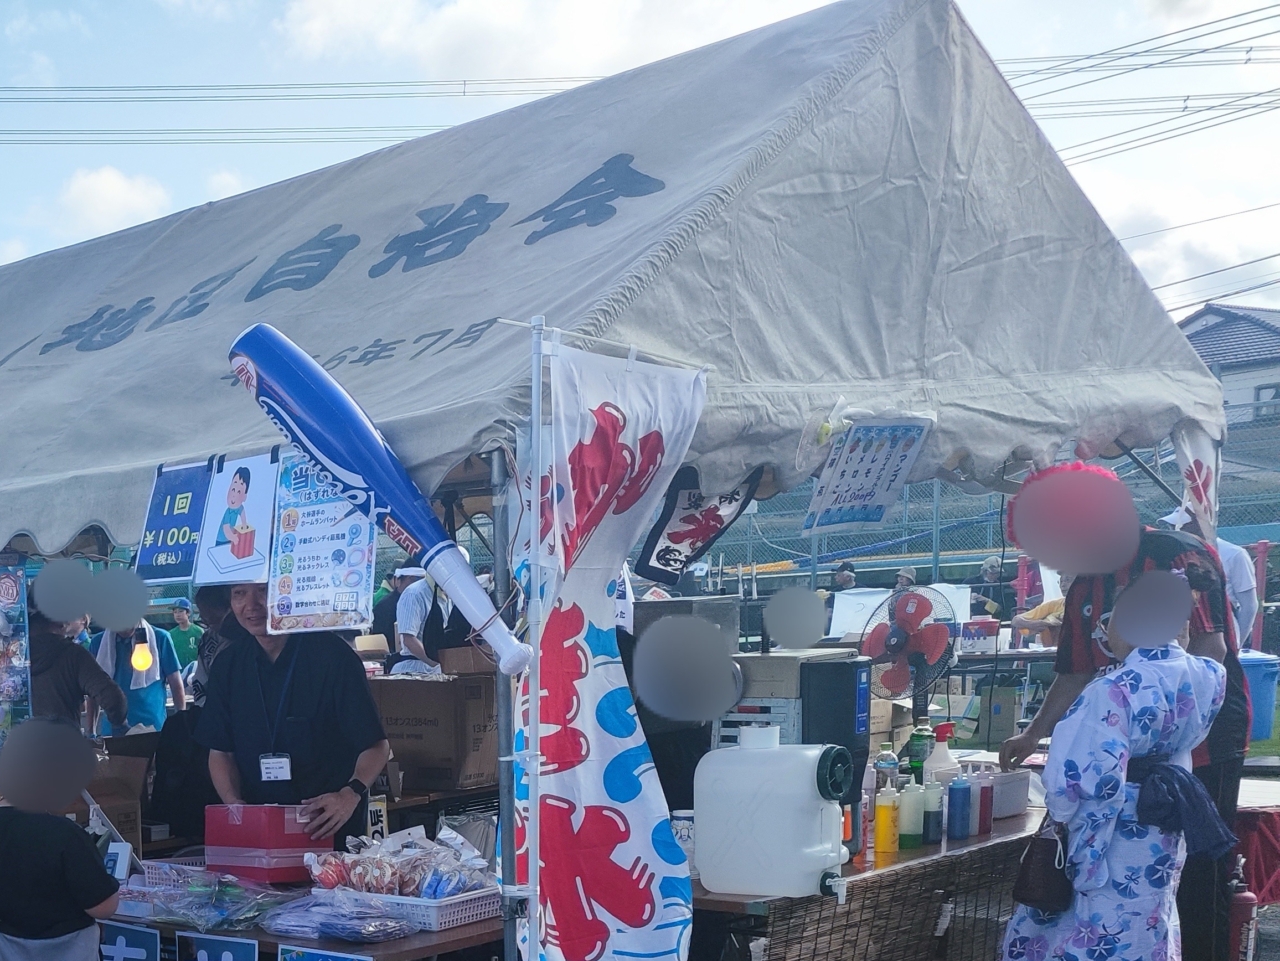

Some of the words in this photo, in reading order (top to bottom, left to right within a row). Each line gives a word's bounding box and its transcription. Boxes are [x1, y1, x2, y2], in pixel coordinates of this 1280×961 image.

[162, 492, 193, 516] 1回
[143, 529, 200, 548] ¥100円
[152, 550, 183, 566] (税込)
